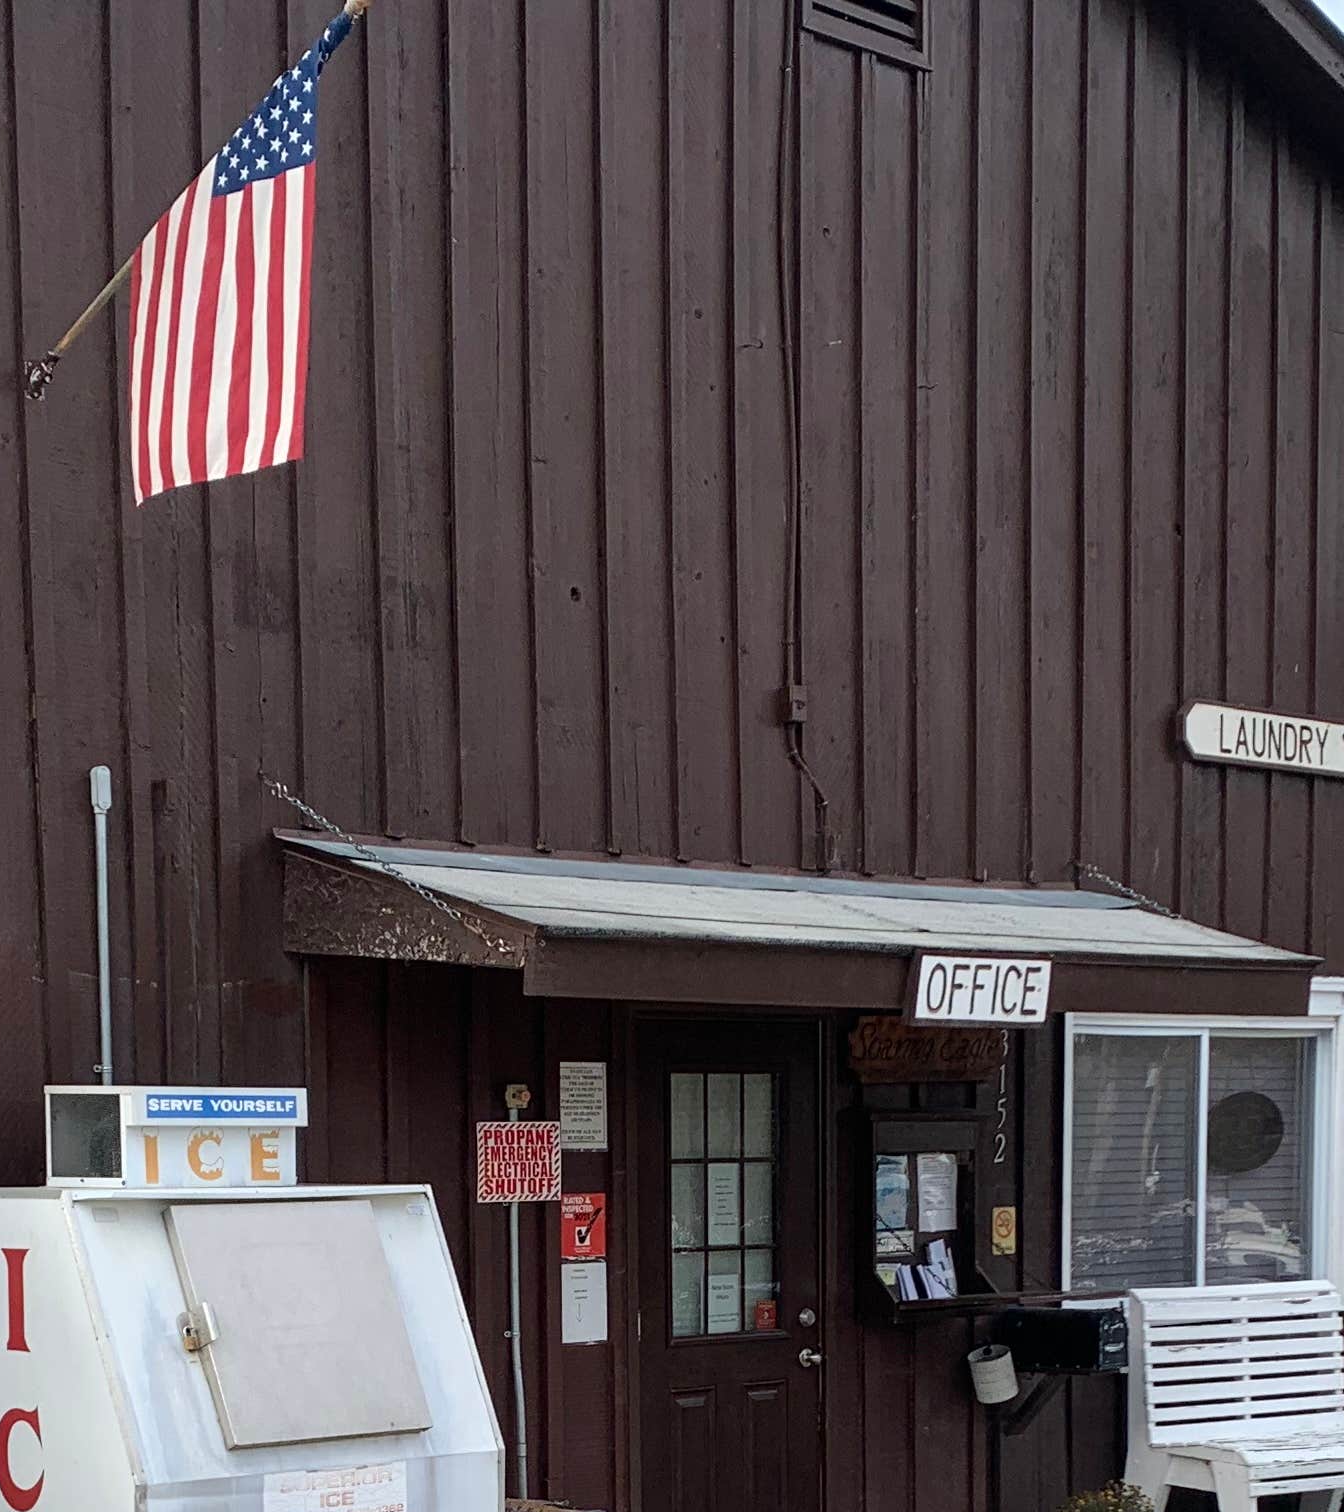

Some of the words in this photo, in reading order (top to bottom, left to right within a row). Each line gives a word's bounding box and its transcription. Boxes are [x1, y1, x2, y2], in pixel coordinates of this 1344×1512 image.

[1219, 714, 1328, 765] LAUNDRY
[926, 963, 1042, 1016] OFFICE
[993, 1029, 1009, 1164] 3152
[148, 1099, 203, 1111] SERVE
[210, 1099, 294, 1112] YOURSELF
[483, 1129, 554, 1146] PROPANE
[141, 1126, 281, 1184] ICE
[484, 1146, 554, 1162] EMERGENCY
[484, 1162, 555, 1178] ELECTRICAL
[484, 1178, 554, 1195] SHUTOFF
[320, 1491, 354, 1508] ICE
